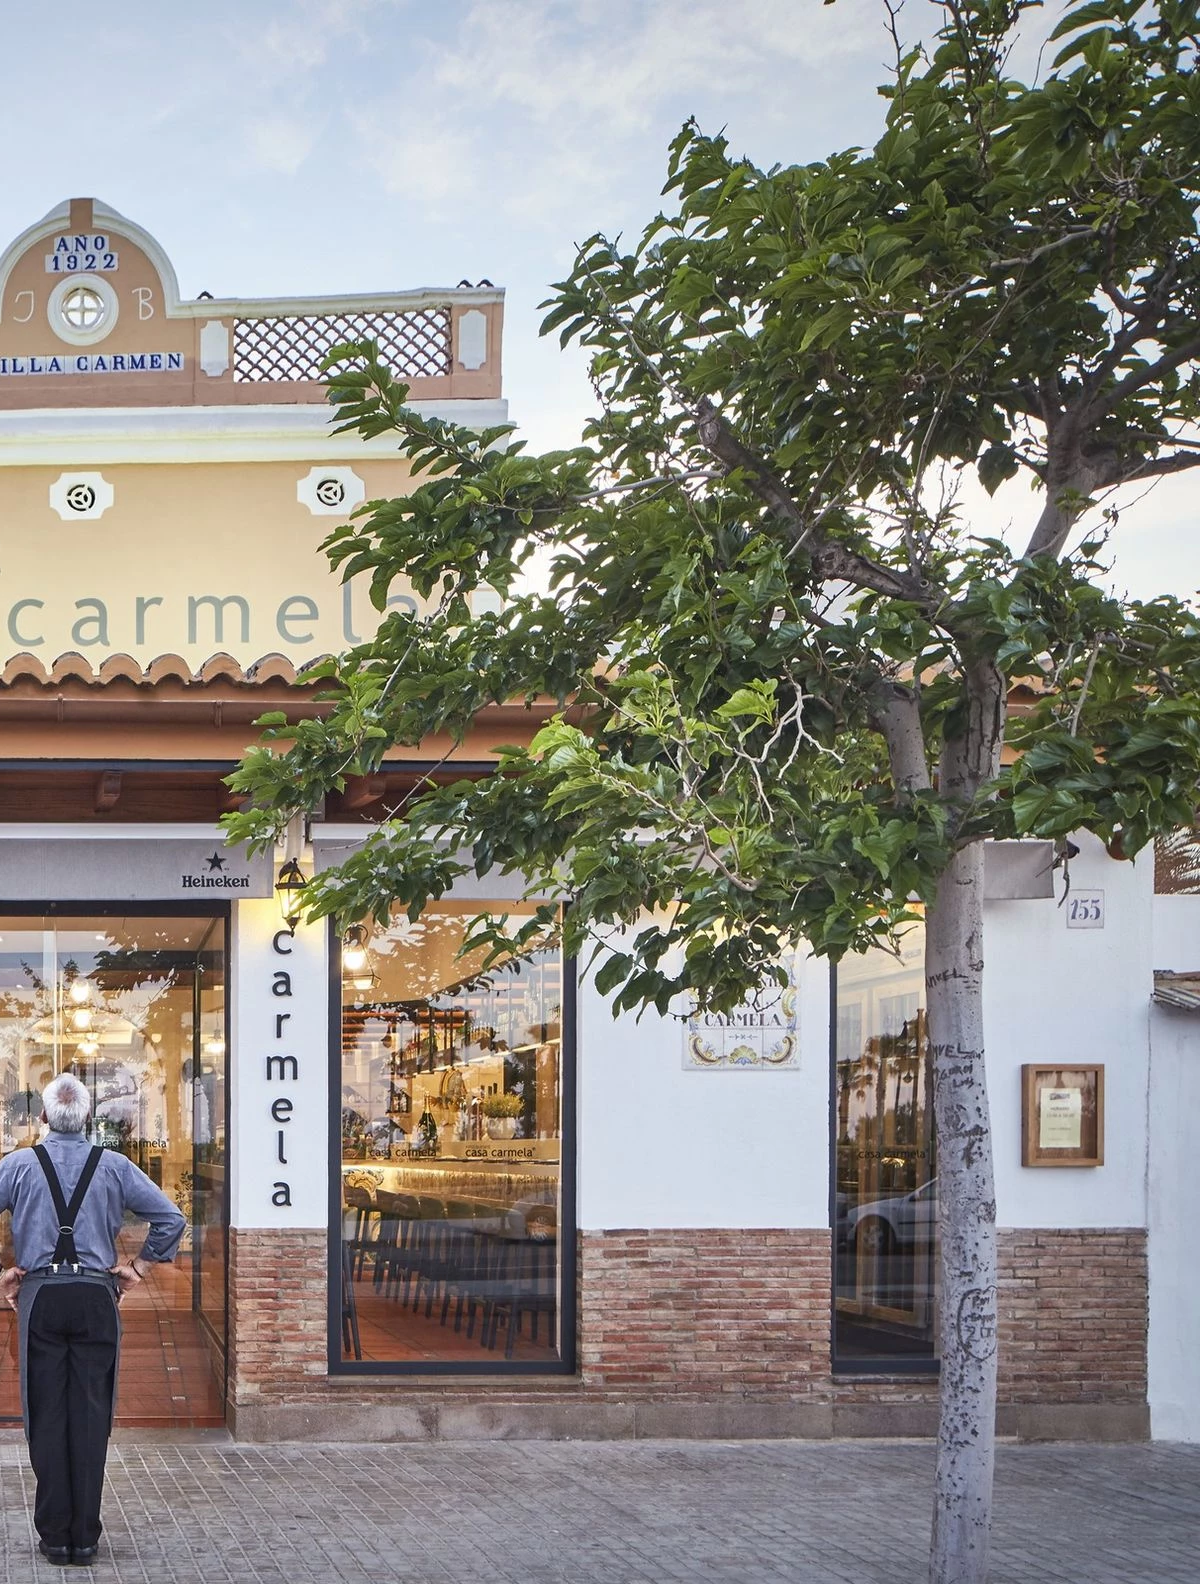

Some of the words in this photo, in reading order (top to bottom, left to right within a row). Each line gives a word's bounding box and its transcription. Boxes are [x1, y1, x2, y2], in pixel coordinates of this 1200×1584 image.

[56, 235, 106, 252] AÑO
[52, 254, 115, 271] 1922
[76, 352, 182, 371] CARMEN
[181, 875, 249, 888] Heineken
[1070, 899, 1101, 920] 155
[704, 1013, 782, 1027] CARMELA
[265, 929, 299, 1207] carmela
[465, 1149, 488, 1157] casa
[491, 1147, 533, 1157] carmela
